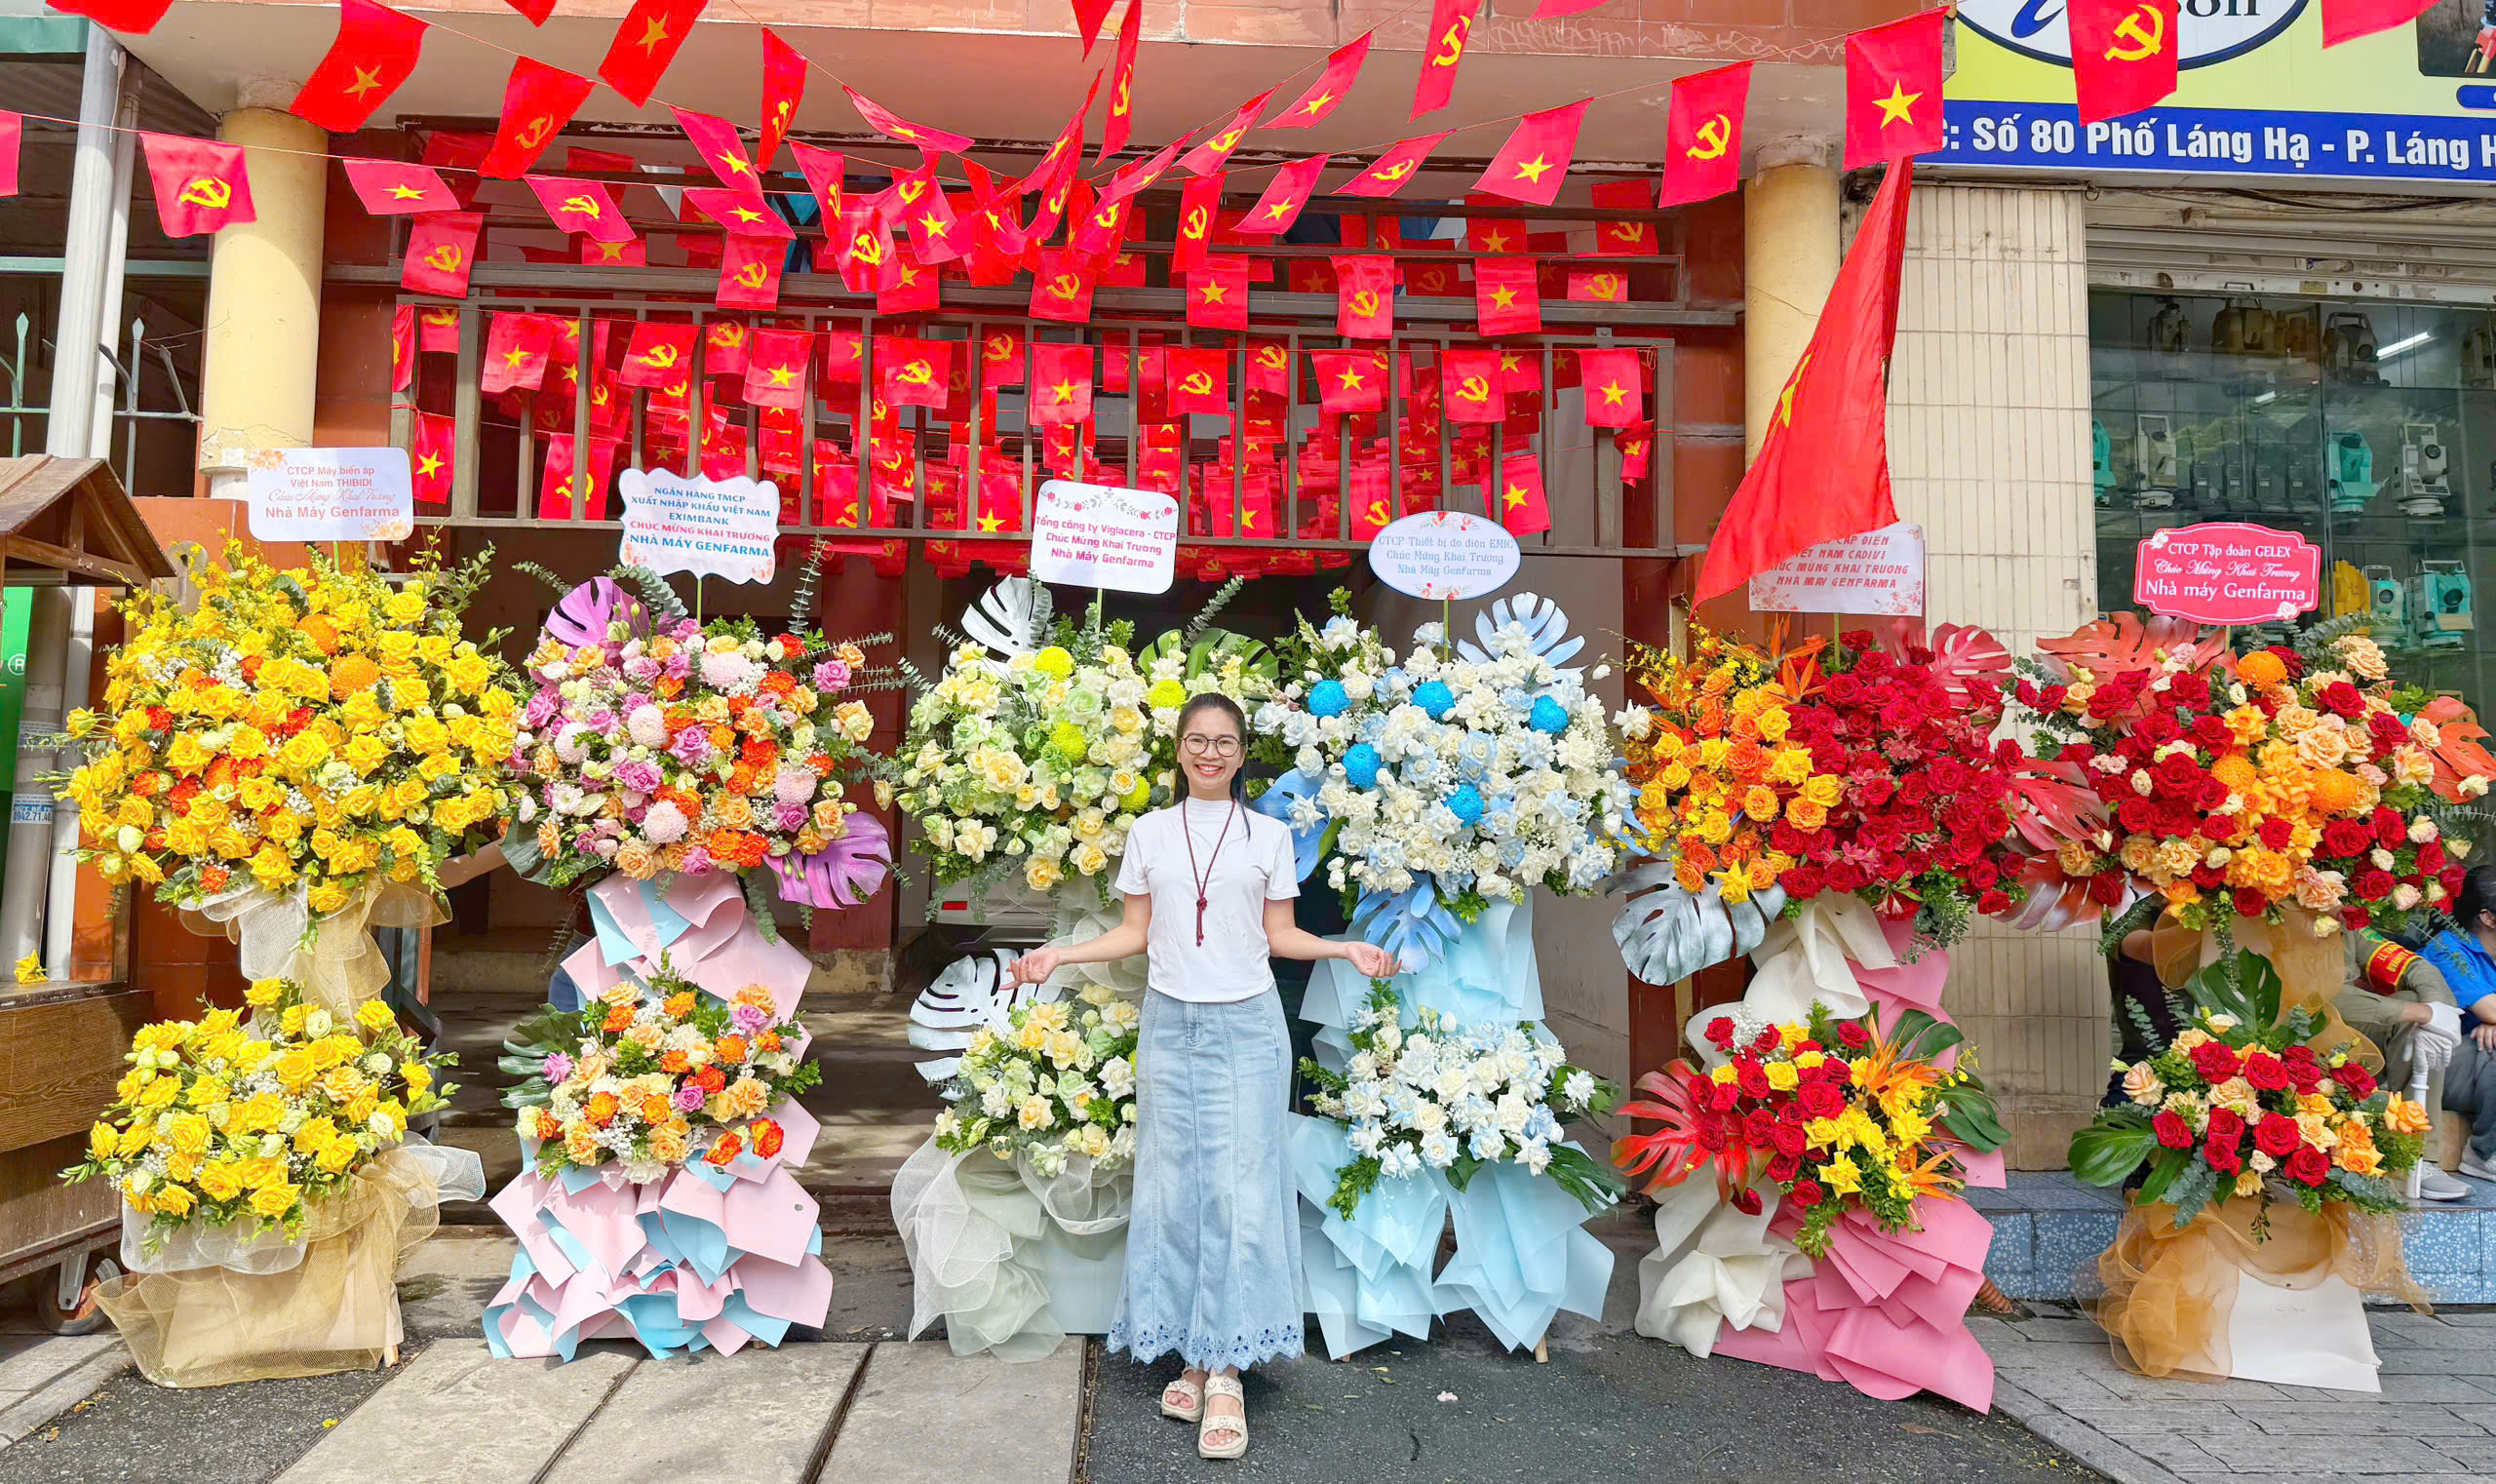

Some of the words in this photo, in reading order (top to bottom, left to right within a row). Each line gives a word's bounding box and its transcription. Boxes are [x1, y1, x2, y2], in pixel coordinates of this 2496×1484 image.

[1972, 113, 2022, 152] Số
[2030, 119, 2075, 154] 80
[2086, 117, 2159, 157] Phố
[2167, 123, 2252, 164] Láng
[2264, 127, 2310, 169] Hạ
[2321, 143, 2335, 152] -
[2346, 130, 2375, 163] P.
[2386, 131, 2470, 171] Láng
[287, 466, 315, 476] CTCP
[290, 479, 309, 489] Việt
[311, 479, 333, 488] Nam
[336, 478, 372, 488] THIBIDI
[717, 493, 746, 503] TMCP
[265, 506, 292, 518] Nhà
[297, 506, 326, 520] Máy
[331, 506, 400, 518] Genfarma
[631, 495, 657, 506] XUẤT
[659, 499, 689, 512] NHẬP
[722, 505, 744, 517] VIỆT
[747, 508, 771, 518] NAM
[669, 512, 729, 526] EXIMBANK
[697, 527, 724, 537] KHAI
[725, 529, 770, 542] TRƯƠNG
[1036, 515, 1060, 529] Tổng
[1062, 520, 1085, 532] công
[1088, 523, 1099, 533] ty
[1102, 524, 1145, 538] Viglacera
[1153, 530, 1176, 541] CTCP
[630, 533, 659, 546] NHÀ
[662, 536, 693, 549] MÁY
[695, 542, 769, 558] GENFARMA
[1046, 532, 1070, 543] Chúc
[1103, 539, 1123, 550] Khai
[1379, 535, 1405, 546] CTCP
[1437, 537, 1447, 549] bị
[1489, 539, 1513, 550] EMIC
[1051, 547, 1072, 559] Nhà
[1076, 550, 1099, 564] Máy
[1102, 553, 1154, 568] Genfarma
[1443, 551, 1465, 562] Khai
[1818, 550, 1845, 559] NAM
[1848, 550, 1887, 561] CADIVI
[2167, 543, 2200, 556] CTCP
[2202, 544, 2223, 559] Tập
[2225, 544, 2252, 557] đoàn
[2254, 545, 2291, 559] GELEX
[1833, 564, 1861, 573] KHAI
[2225, 561, 2257, 577] Khai
[1831, 577, 1896, 588] GENFARMA
[2145, 578, 2177, 597] Nhà
[2184, 580, 2217, 601] máy
[2224, 582, 2306, 601] Genfarma
